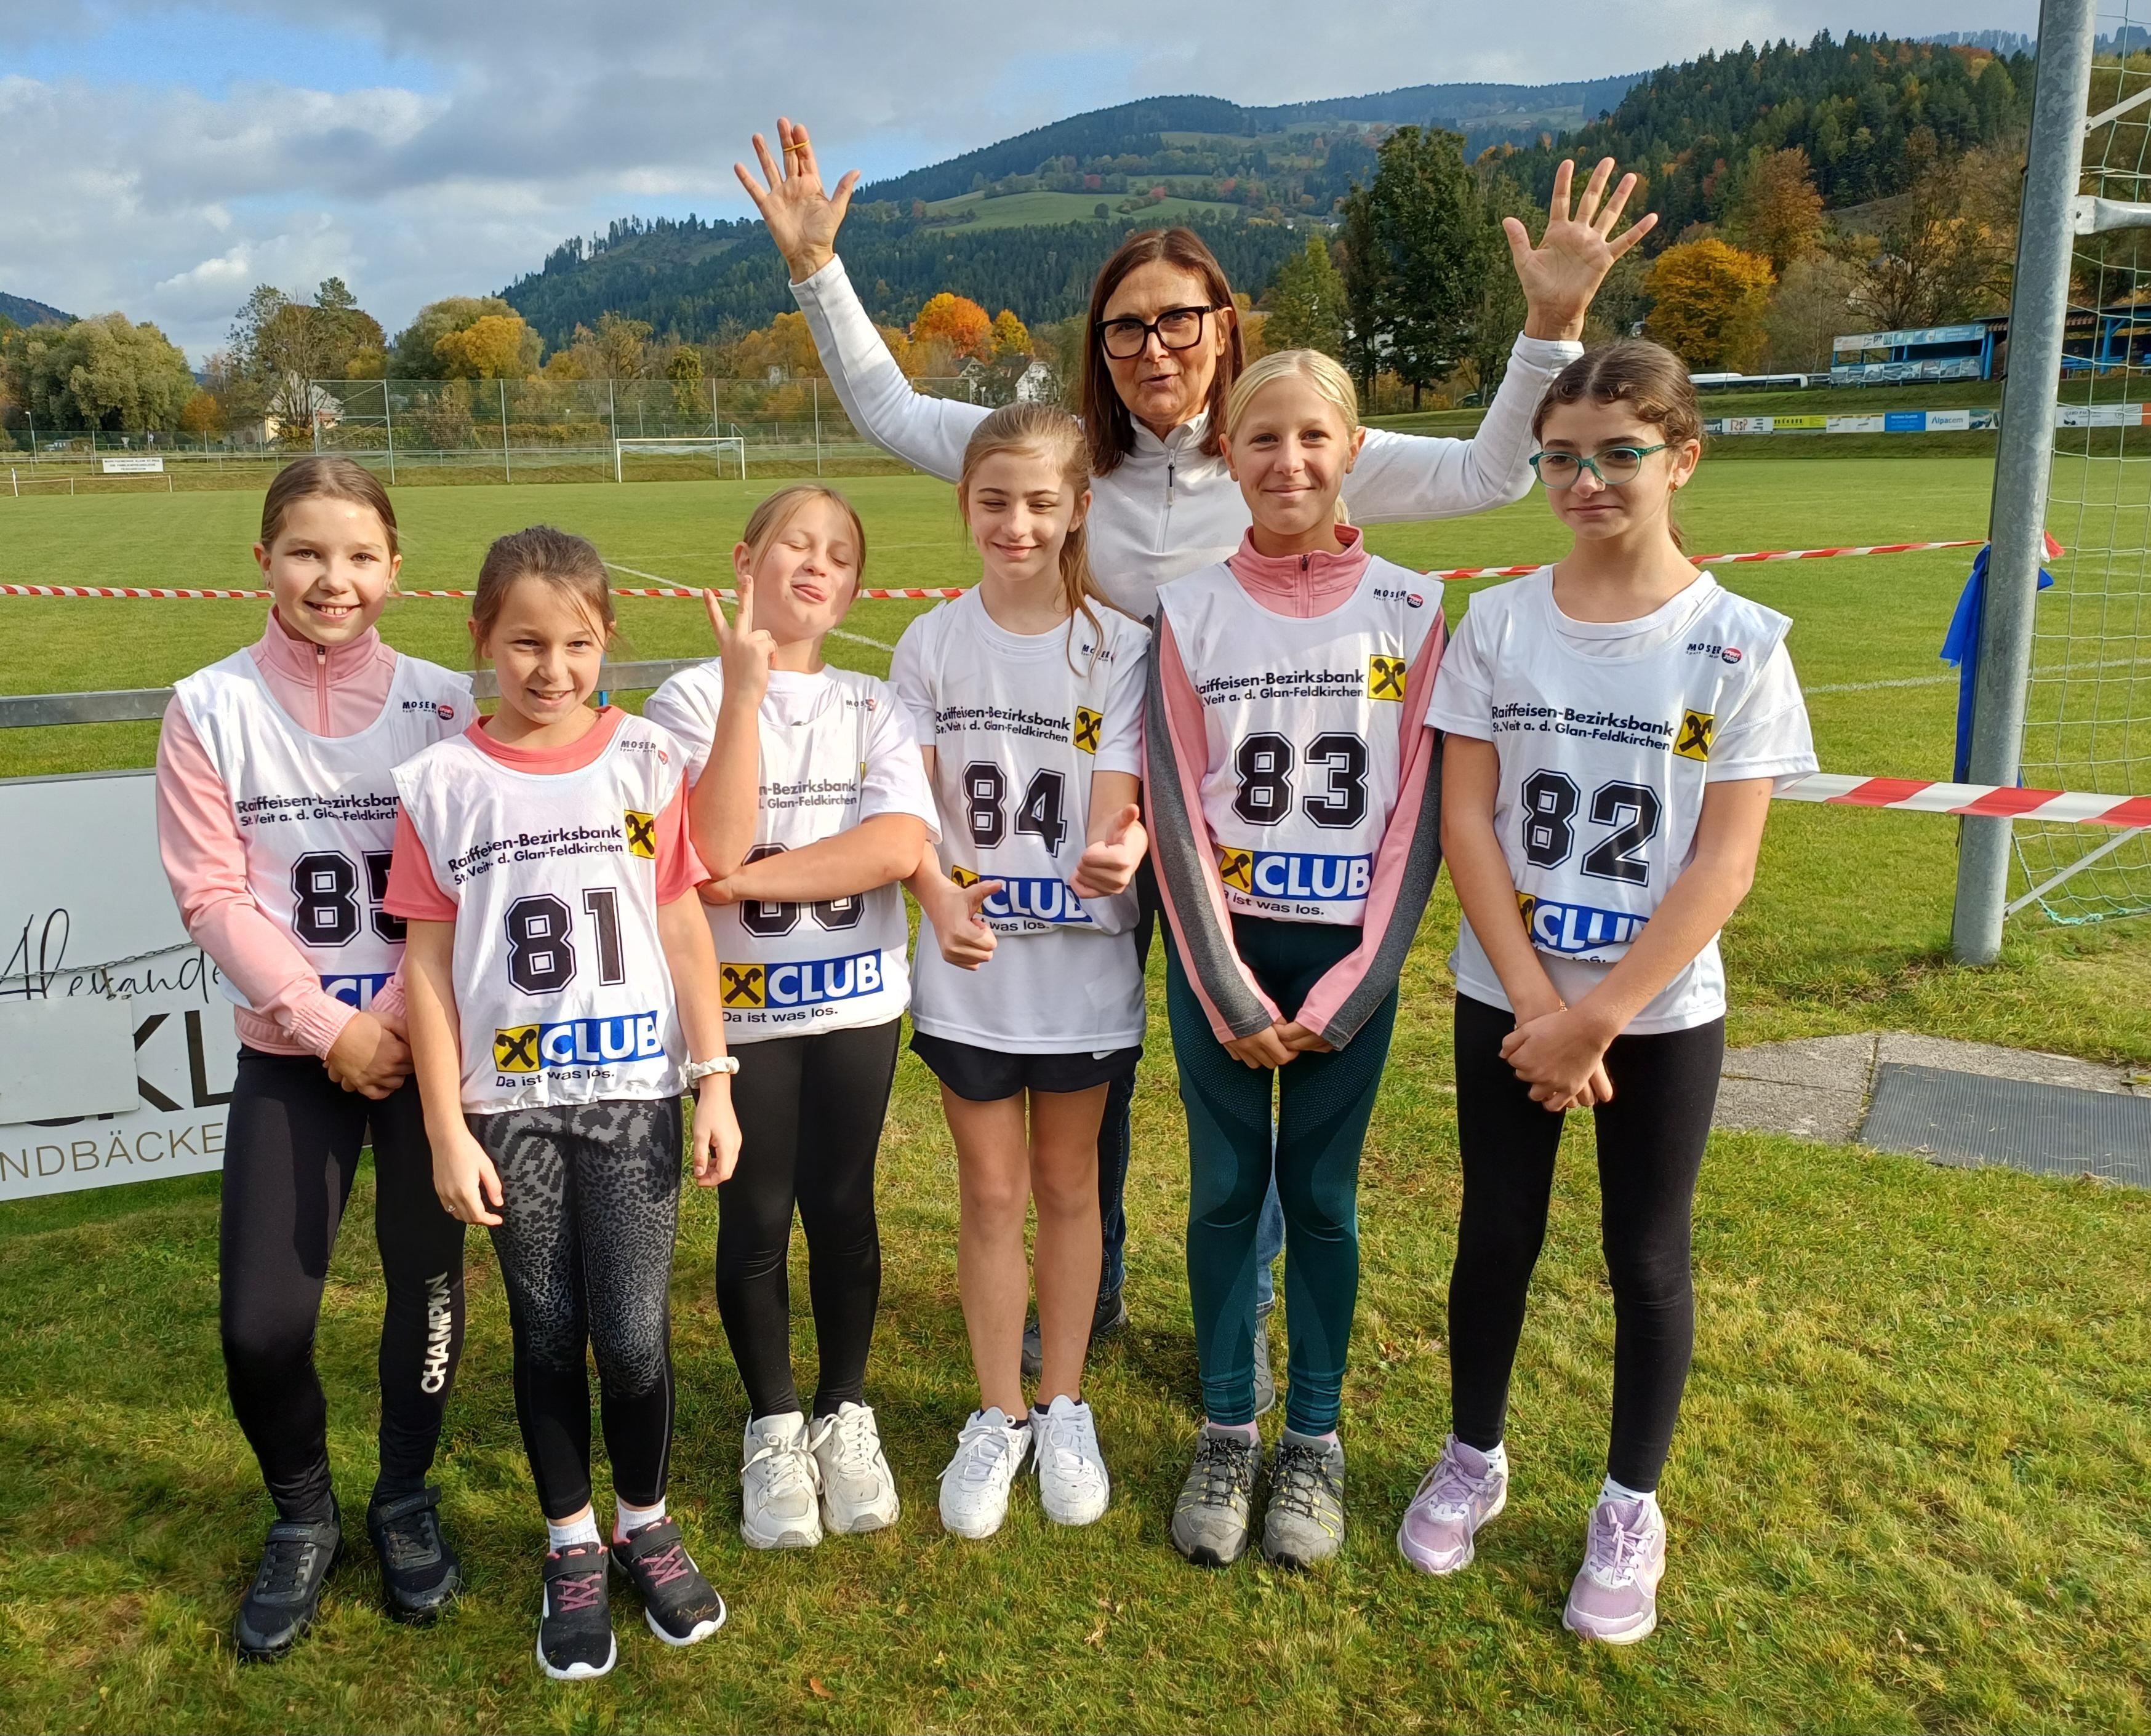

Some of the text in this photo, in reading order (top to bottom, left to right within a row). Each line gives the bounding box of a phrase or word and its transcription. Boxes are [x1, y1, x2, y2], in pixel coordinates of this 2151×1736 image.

[1931, 415, 1963, 425] Alpacem
[1687, 642, 1722, 654] MOSER
[403, 701, 436, 710] MOSER
[1244, 689, 1256, 700] d.
[1260, 686, 1363, 698] Glan-Feldkirchen
[935, 706, 1071, 731] Raiffeisen-Bezirksbank
[969, 720, 981, 730] d.
[1492, 703, 1675, 737] Raiffeisen-Bezirksbank
[620, 740, 656, 750] MOSER
[1523, 722, 1535, 731] a.
[1539, 720, 1551, 732] d.
[1555, 722, 1670, 751] Glan-Feldkirchen
[759, 778, 857, 796] n-Bezirksbank
[1232, 731, 1369, 829] 83
[279, 814, 292, 822] a.
[296, 809, 310, 820] d.
[961, 761, 1068, 858] 84
[1522, 768, 1662, 887] 82
[448, 825, 622, 873] Raiffeien-Bezirksbank
[497, 852, 510, 865] d.
[514, 841, 623, 862] Glan-Feldkirchen
[1254, 855, 1371, 897] CLUB
[290, 850, 407, 948] 85
[1233, 893, 1251, 906] ist
[1256, 900, 1290, 913] was
[1296, 904, 1324, 916] los.
[990, 920, 1050, 931] was los.
[503, 887, 627, 996] 81
[0, 908, 219, 1004] Alexande
[768, 954, 881, 1004] CLUB
[748, 1012, 767, 1023] ist
[772, 1011, 806, 1022] was
[811, 1007, 838, 1018] los.
[541, 1016, 663, 1064] CLUB
[495, 1069, 615, 1087] Da ist was los.
[0, 1122, 225, 1182] NDBÄCKE
